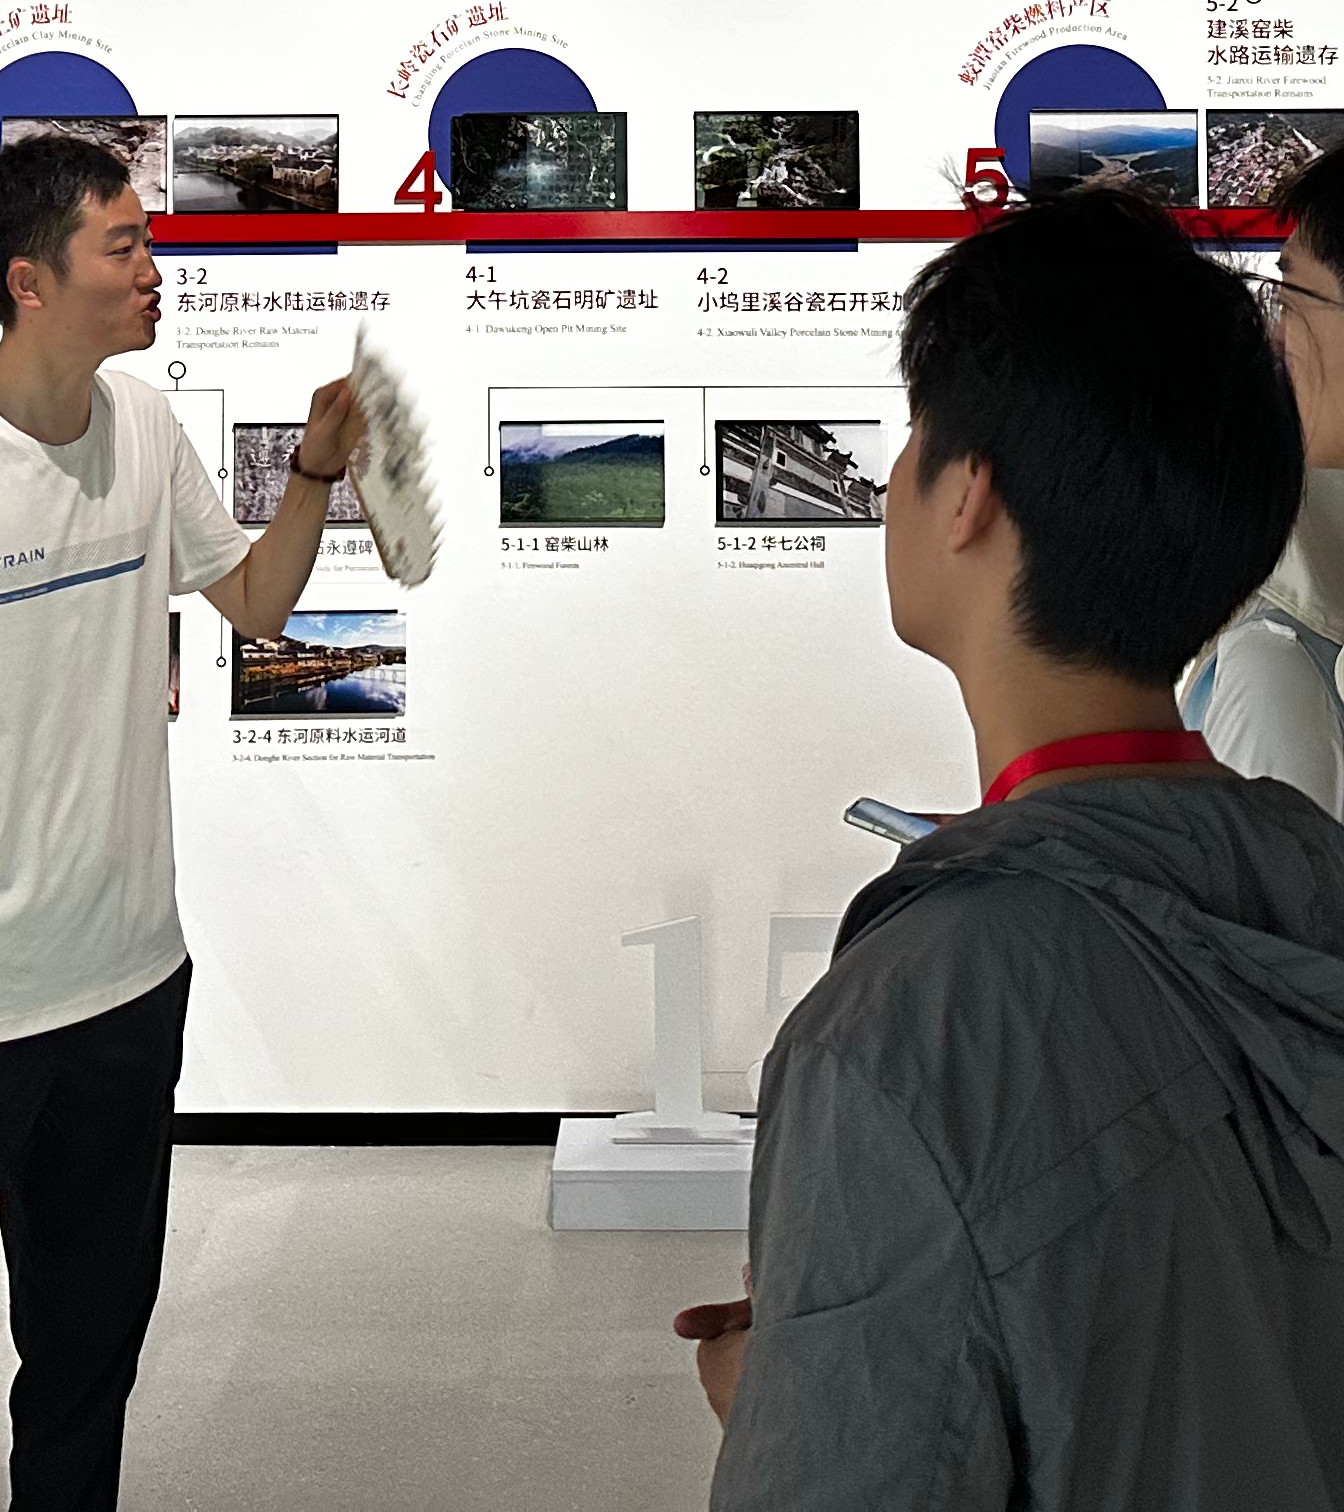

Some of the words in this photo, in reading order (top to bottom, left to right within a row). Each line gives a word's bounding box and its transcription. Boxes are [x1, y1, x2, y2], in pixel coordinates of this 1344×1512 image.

[482, 28, 511, 41] Stone
[513, 26, 549, 42] Mining
[550, 36, 569, 50] Site
[1047, 24, 1103, 37] Production
[1104, 27, 1128, 42] Area
[1207, 19, 1294, 39] 建溪窑柴
[32, 30, 55, 42] Clay
[57, 29, 93, 47] Mining
[95, 38, 113, 55] Site
[387, 1, 510, 100] 长岭瓷石矿遗址
[1207, 45, 1339, 66] 水路运输遗存
[1256, 75, 1280, 85] River
[394, 150, 443, 212] 4
[963, 147, 1010, 211] 5
[176, 267, 208, 286] 3-2
[465, 266, 497, 284] 4-1
[697, 267, 728, 285] 4-2
[176, 291, 390, 313] 东河原料水陆运输遗存
[465, 289, 658, 311] 大午坑瓷石明矿遗址
[233, 326, 256, 336] River
[534, 324, 559, 335] Open
[760, 327, 787, 339] Valley
[790, 327, 831, 338] Porcelain
[833, 327, 858, 337] Stone
[501, 537, 540, 551] 5-1-1
[545, 535, 609, 552] 窑柴山林
[717, 536, 756, 551] 5-1-2
[761, 535, 826, 552] 华七公祠
[232, 729, 272, 744] 3-2-4
[277, 727, 407, 745] 东河原料水运河道
